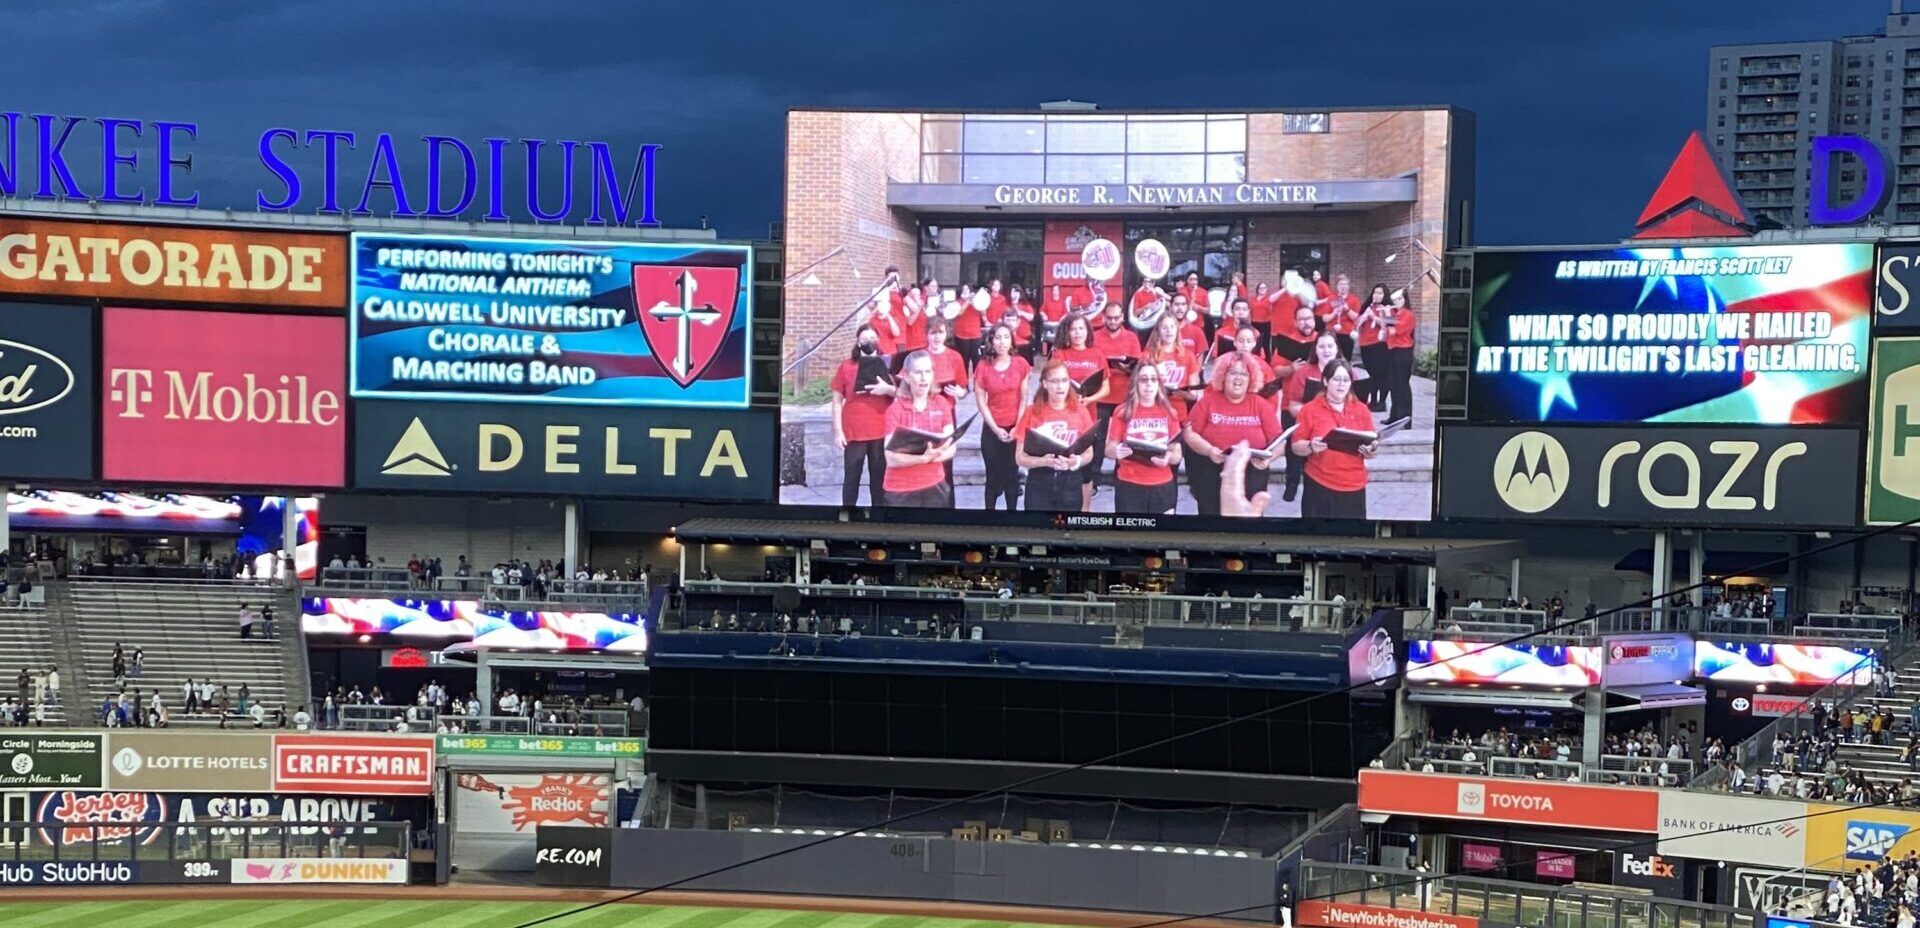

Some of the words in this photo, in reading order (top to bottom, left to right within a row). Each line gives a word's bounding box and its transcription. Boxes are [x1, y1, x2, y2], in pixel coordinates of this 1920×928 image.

[257, 127, 663, 226] STADIUM
[995, 185, 1080, 204] GEORGE
[1093, 186, 1114, 204] R.
[1127, 185, 1223, 204] NEWMAN
[1236, 184, 1318, 203] CENTER
[0, 233, 322, 292] GATORADE
[377, 248, 507, 272] PERFORMING
[510, 253, 614, 273] TONIGHT'S
[1555, 260, 1576, 279] AS
[1577, 259, 1639, 278] WRITTEN
[1639, 259, 1661, 276] BY
[1660, 258, 1718, 276] FRANCIS
[1719, 257, 1765, 275] SCOTT
[1764, 256, 1793, 274] KEY
[400, 273, 498, 293] NATIONAL
[500, 277, 592, 297] ANTHEM:
[364, 296, 486, 322] CALDWELL
[491, 302, 627, 328] UNIVERSITY
[1508, 314, 1574, 341] WHAT
[1577, 314, 1608, 341] SO
[1611, 313, 1712, 341] PROUDLY
[1714, 313, 1751, 340] WE
[1754, 312, 1833, 339] HAILED
[428, 329, 535, 354] CHORALE
[540, 335, 562, 355] &
[1476, 346, 1505, 373] AT
[1508, 346, 1549, 372] THE
[1554, 346, 1681, 372] TWILIGHT'S
[1684, 345, 1742, 372] LAST
[1743, 344, 1861, 374] GLEAMING,
[392, 356, 524, 384] MARCHING
[529, 361, 597, 386] BAND
[164, 370, 340, 426] Mobile
[478, 423, 749, 478] DELTA
[1597, 440, 1808, 511] razr
[1067, 516, 1113, 526] MITSUBISHI
[1116, 517, 1157, 527] ELECTRIC
[3, 740, 30, 748] Circle
[38, 740, 96, 749] Morningside
[442, 738, 487, 749] bet365
[519, 739, 564, 750] bet365
[595, 741, 640, 753] bet365
[147, 756, 204, 769] LOTTE
[207, 757, 268, 769] HOTELS
[286, 754, 422, 776] CRAFTSMAN
[540, 786, 573, 796] FRANK'S
[1490, 793, 1553, 811] TOYOTA
[54, 791, 149, 819] Jersey
[531, 796, 583, 812] RedHot
[279, 798, 378, 835] ABOVE
[1664, 818, 1696, 830] BANK
[1700, 821, 1714, 831] OF
[1718, 823, 1772, 837] AMERICA
[1847, 827, 1895, 856] SAP
[536, 848, 602, 868] RE.COM
[1622, 853, 1674, 878] FedEx
[42, 862, 131, 883] StubHub
